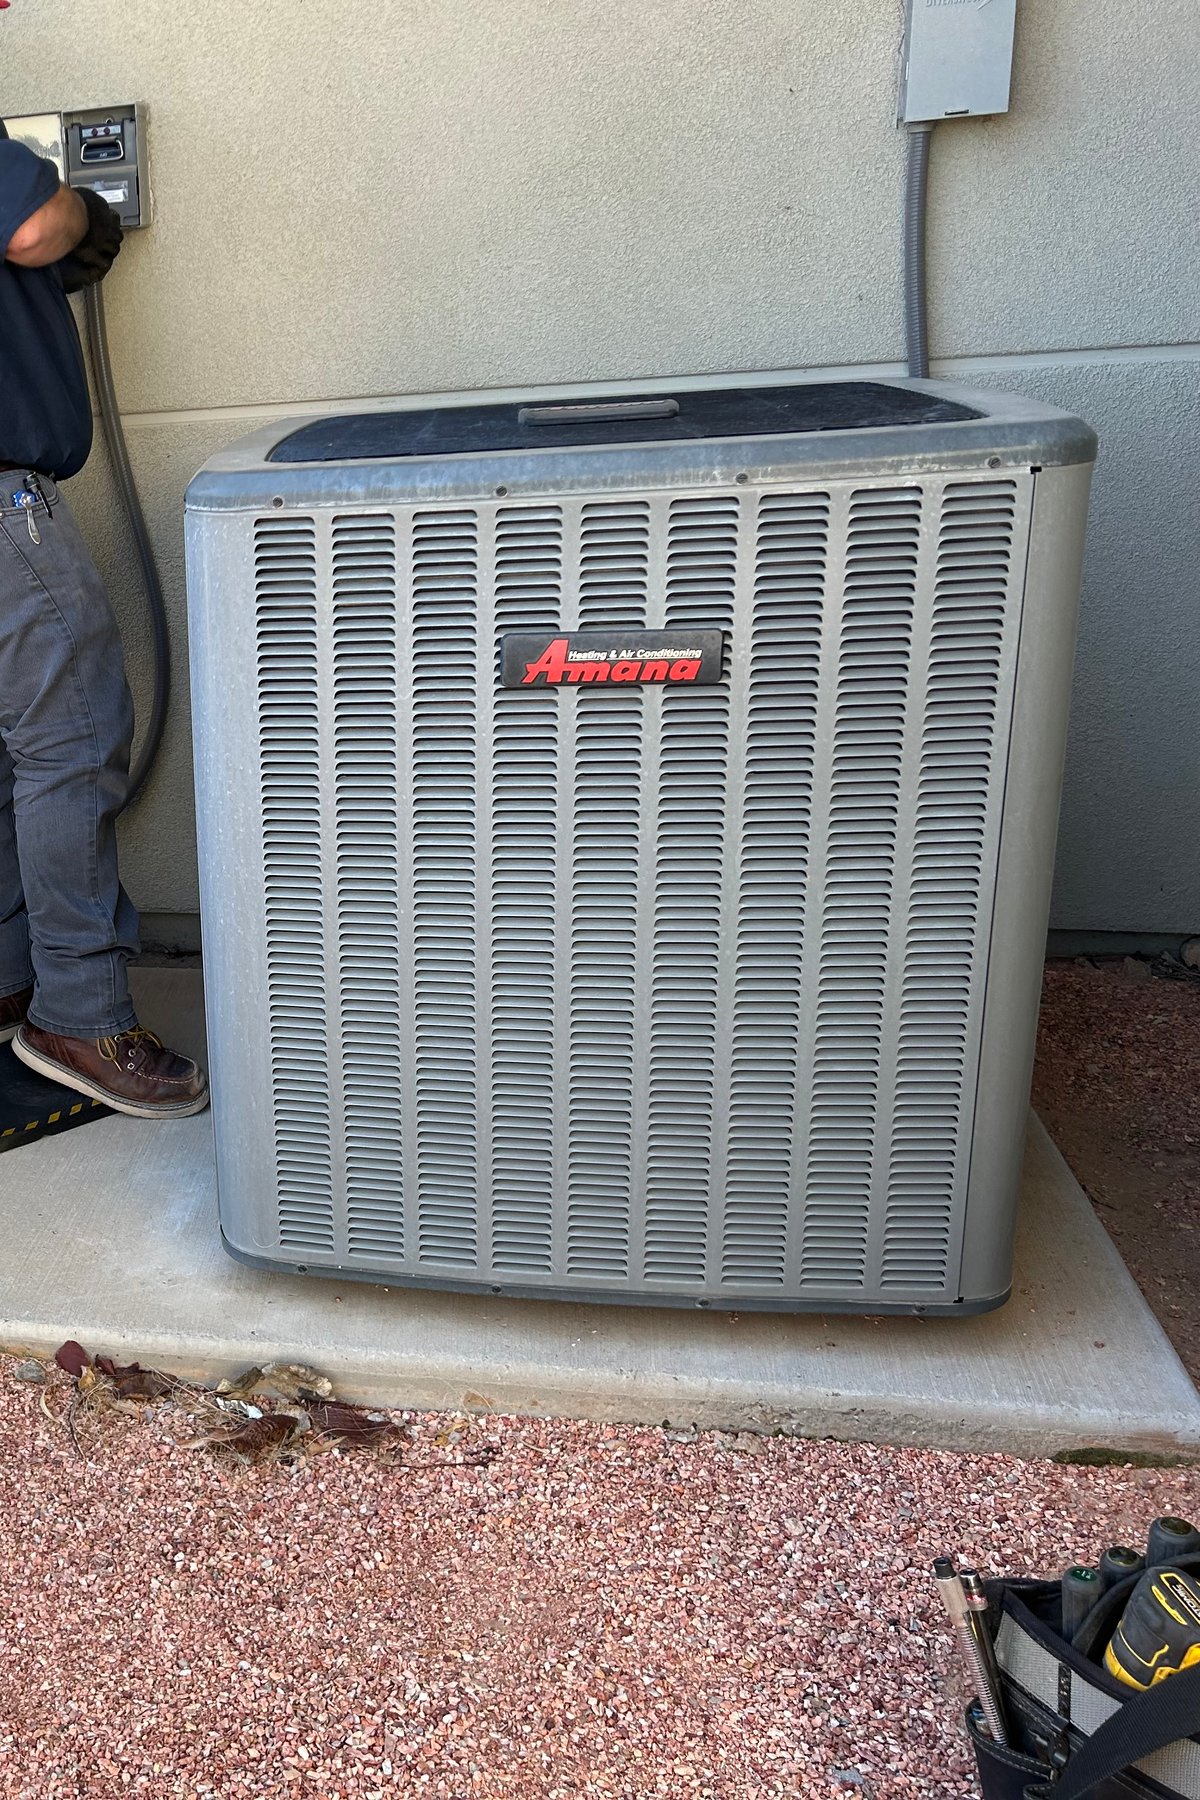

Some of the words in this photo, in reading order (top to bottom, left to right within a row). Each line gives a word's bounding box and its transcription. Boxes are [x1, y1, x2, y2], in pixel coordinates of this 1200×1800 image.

[521, 638, 702, 683] Amana
[568, 650, 607, 661] Heating
[609, 649, 617, 658] &
[619, 649, 635, 658] Air
[636, 648, 702, 659] Conditioning
